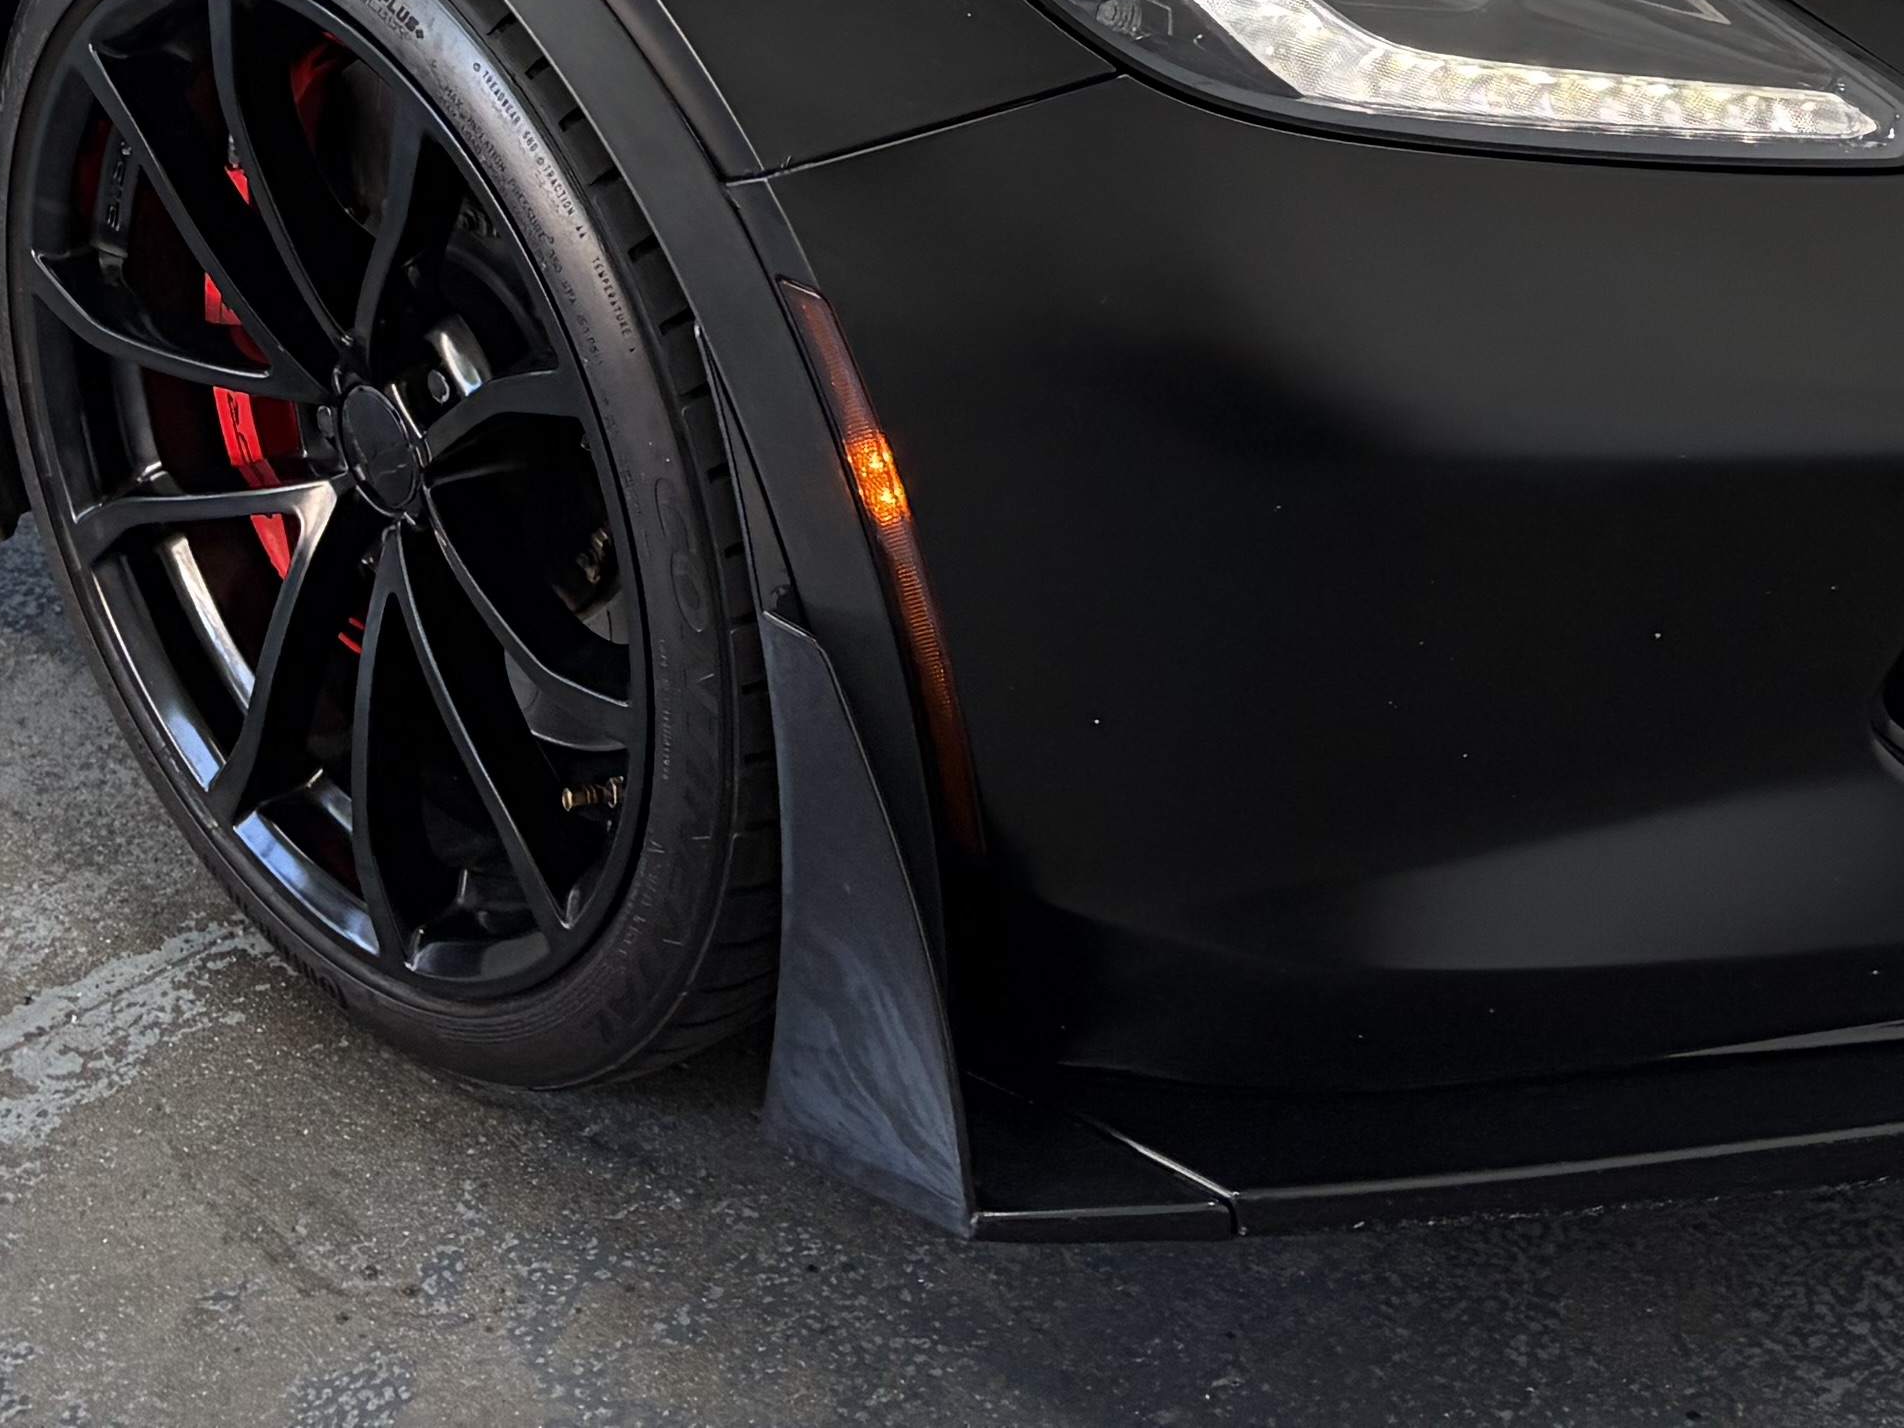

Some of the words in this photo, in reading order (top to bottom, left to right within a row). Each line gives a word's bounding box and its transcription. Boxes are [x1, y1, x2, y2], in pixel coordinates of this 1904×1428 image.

[482, 70, 522, 126] TREADWEAR
[543, 164, 576, 217] TRACTION
[592, 256, 633, 337] TEMPERATURE
